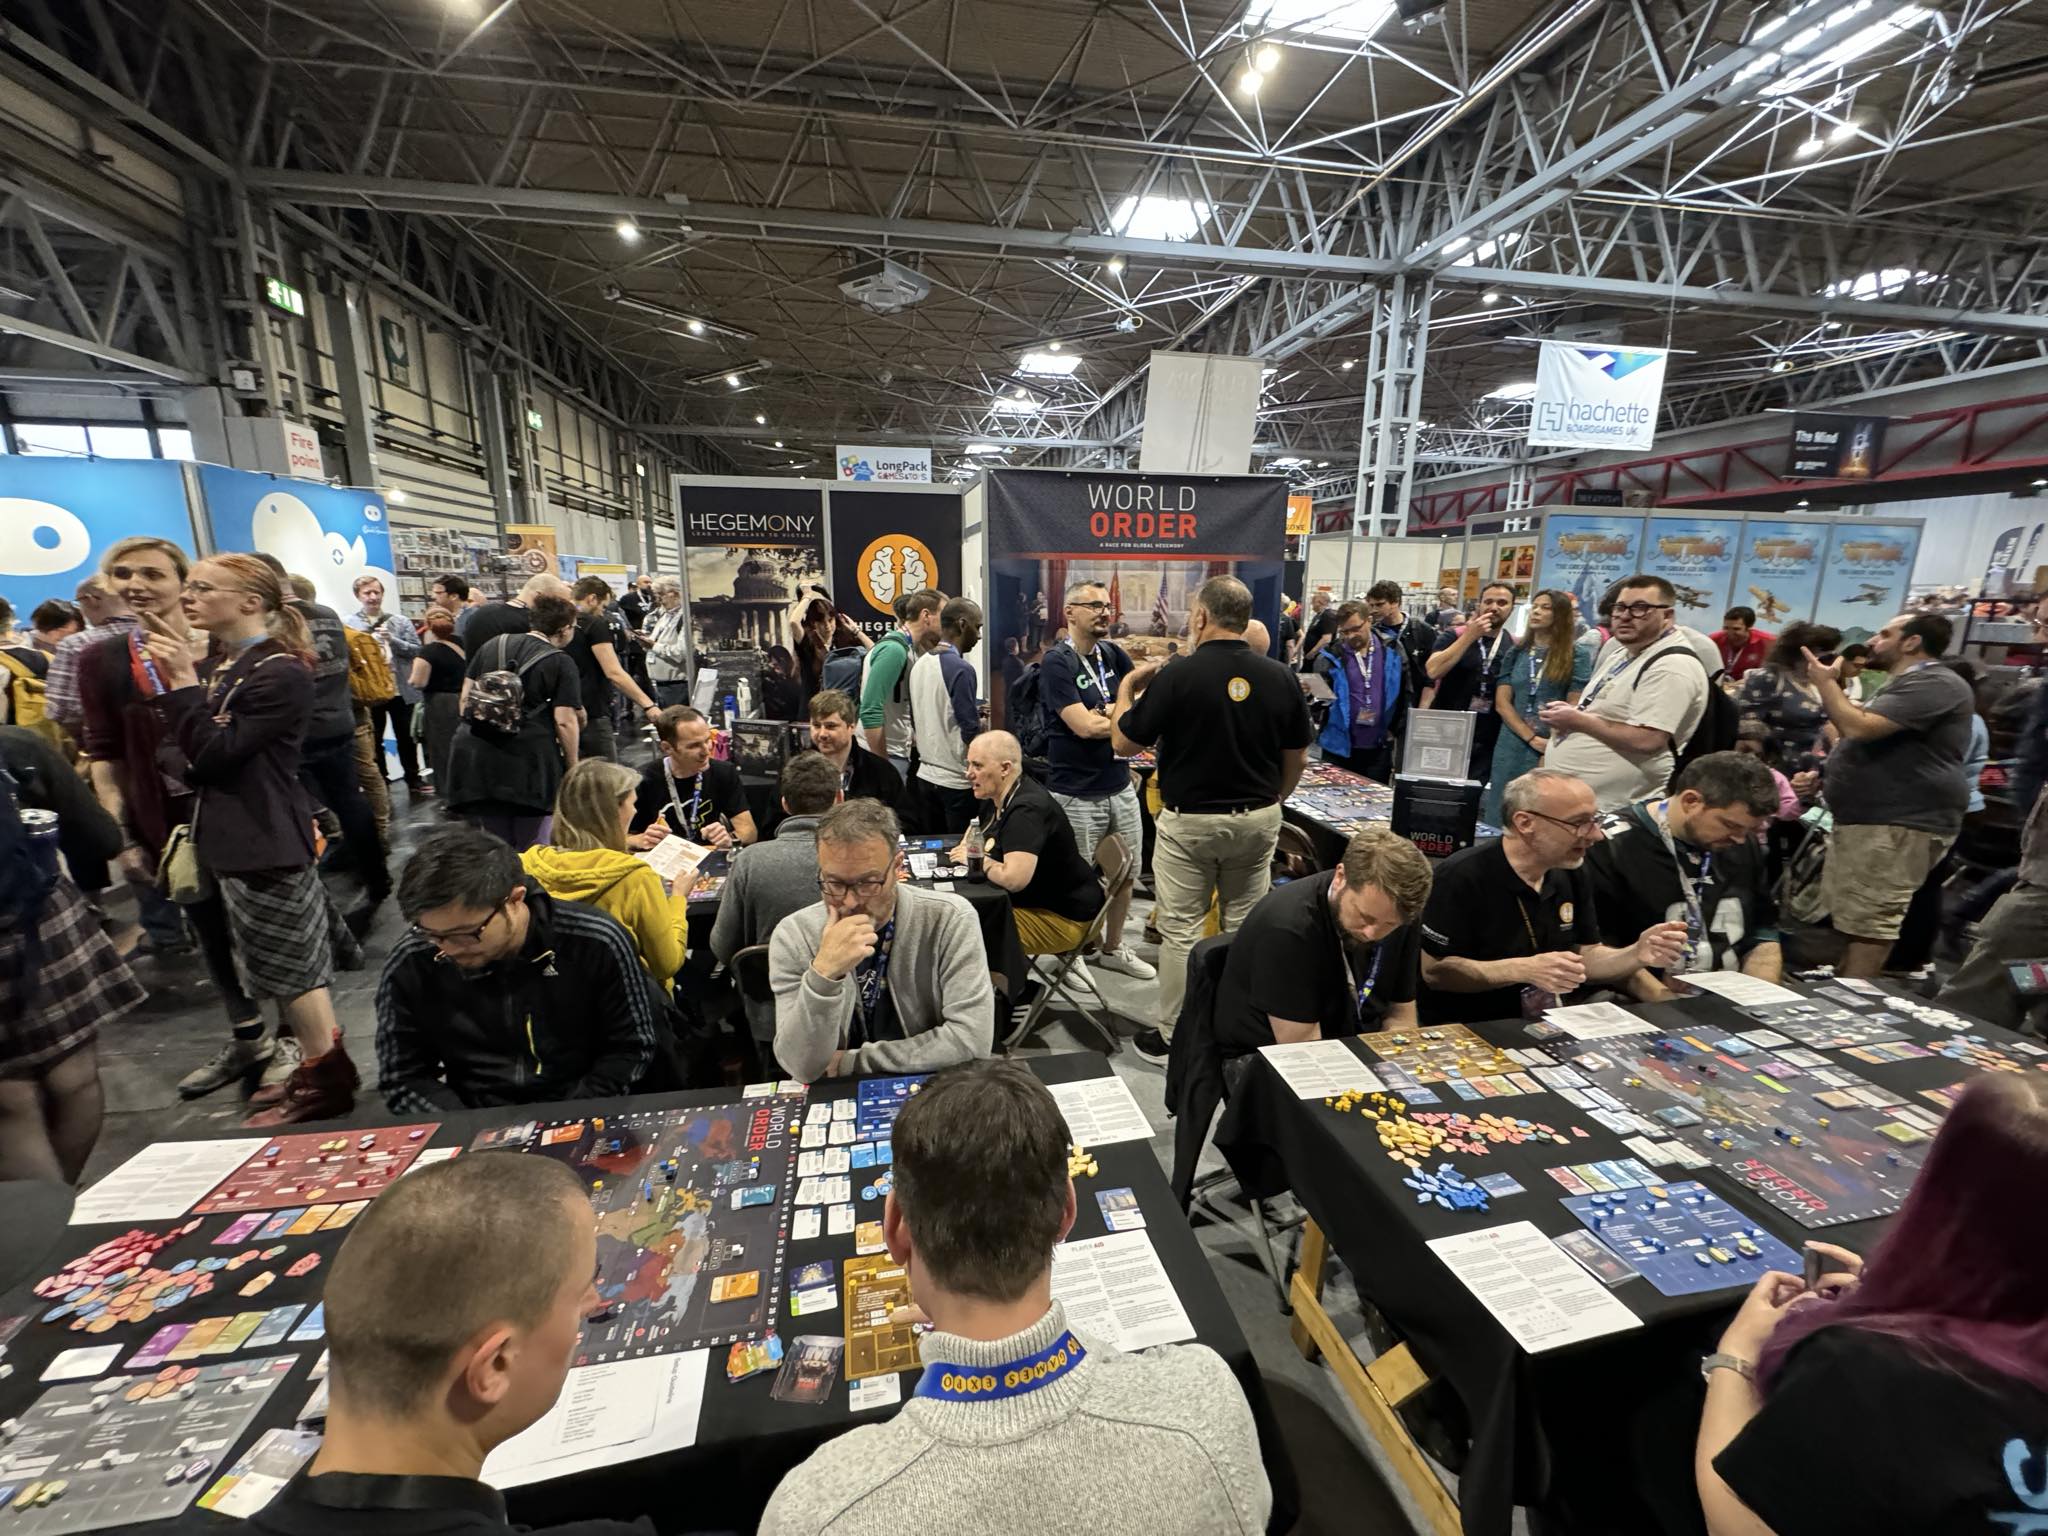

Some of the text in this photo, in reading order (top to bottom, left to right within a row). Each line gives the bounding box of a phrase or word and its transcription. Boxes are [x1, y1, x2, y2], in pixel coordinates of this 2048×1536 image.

[1568, 397, 1650, 424] hachette
[291, 432, 314, 450] Fire
[1626, 426, 1640, 436] UK
[291, 454, 320, 470] point
[876, 460, 928, 473] LongPack
[1087, 484, 1196, 511] WORLD
[689, 513, 815, 532] HEGEMONY
[1090, 511, 1197, 538] ORDER
[1410, 832, 1454, 844] WORLD
[748, 1108, 771, 1152] ORDER
[765, 1106, 786, 1149] WORLD
[1744, 1158, 1829, 1210] ORDER
[942, 1350, 1067, 1391] GAMES EXPO
